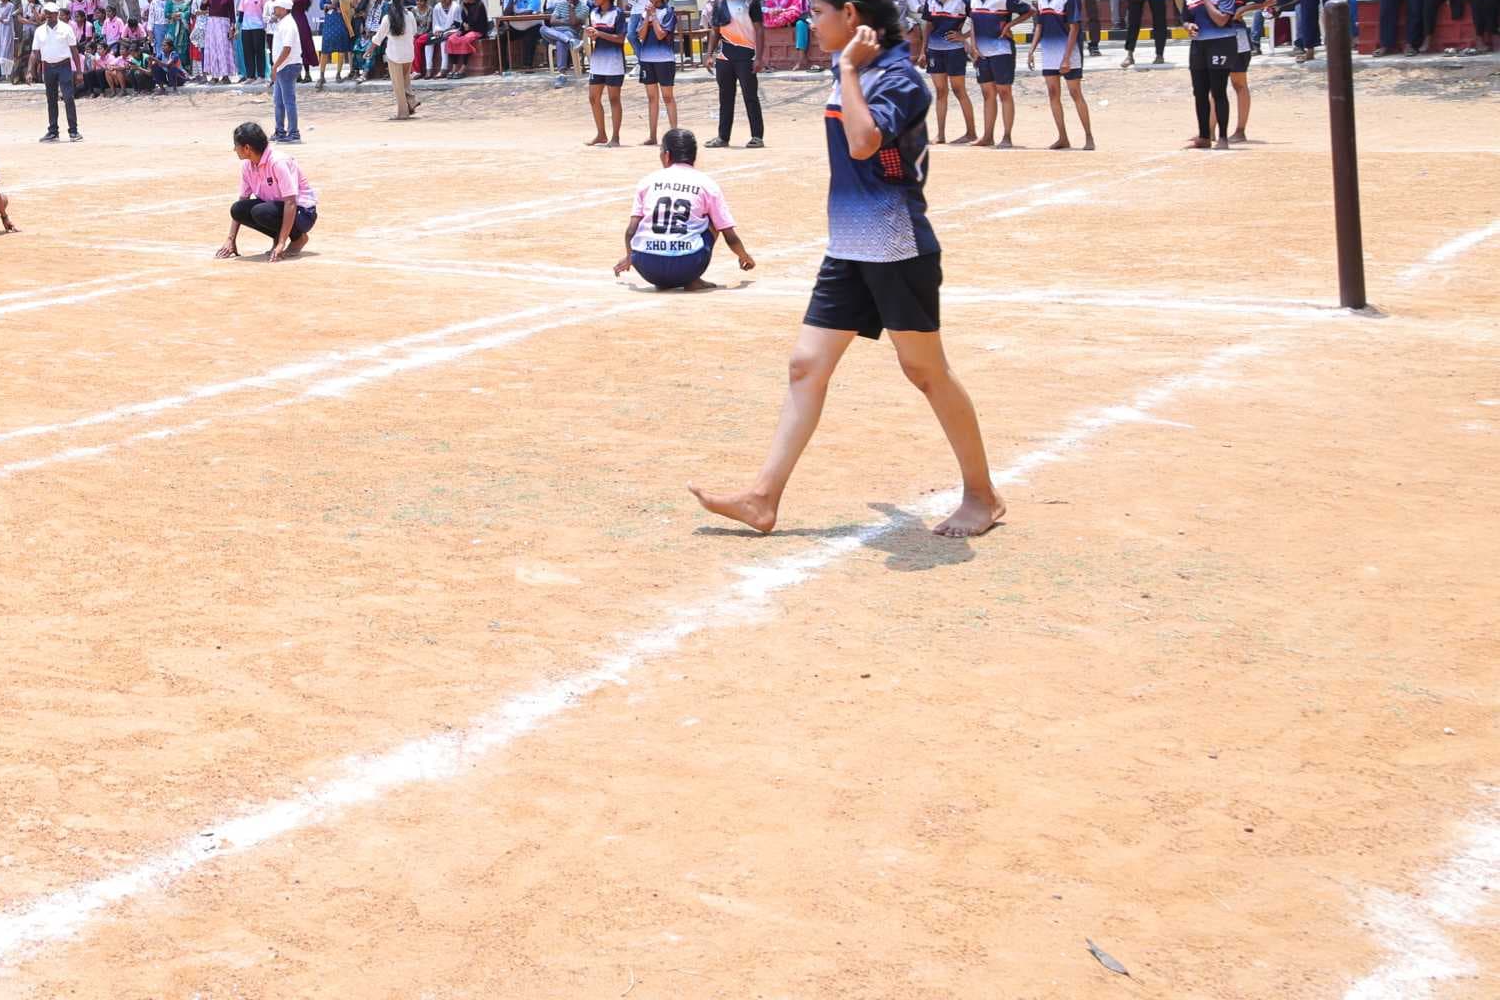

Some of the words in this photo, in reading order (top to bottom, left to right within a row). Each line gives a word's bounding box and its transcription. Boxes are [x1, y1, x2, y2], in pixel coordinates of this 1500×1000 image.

[1212, 55, 1227, 66] 27
[654, 182, 701, 195] MADHU
[652, 196, 692, 234] 02
[645, 240, 667, 251] KHO
[669, 240, 693, 251] KHO
